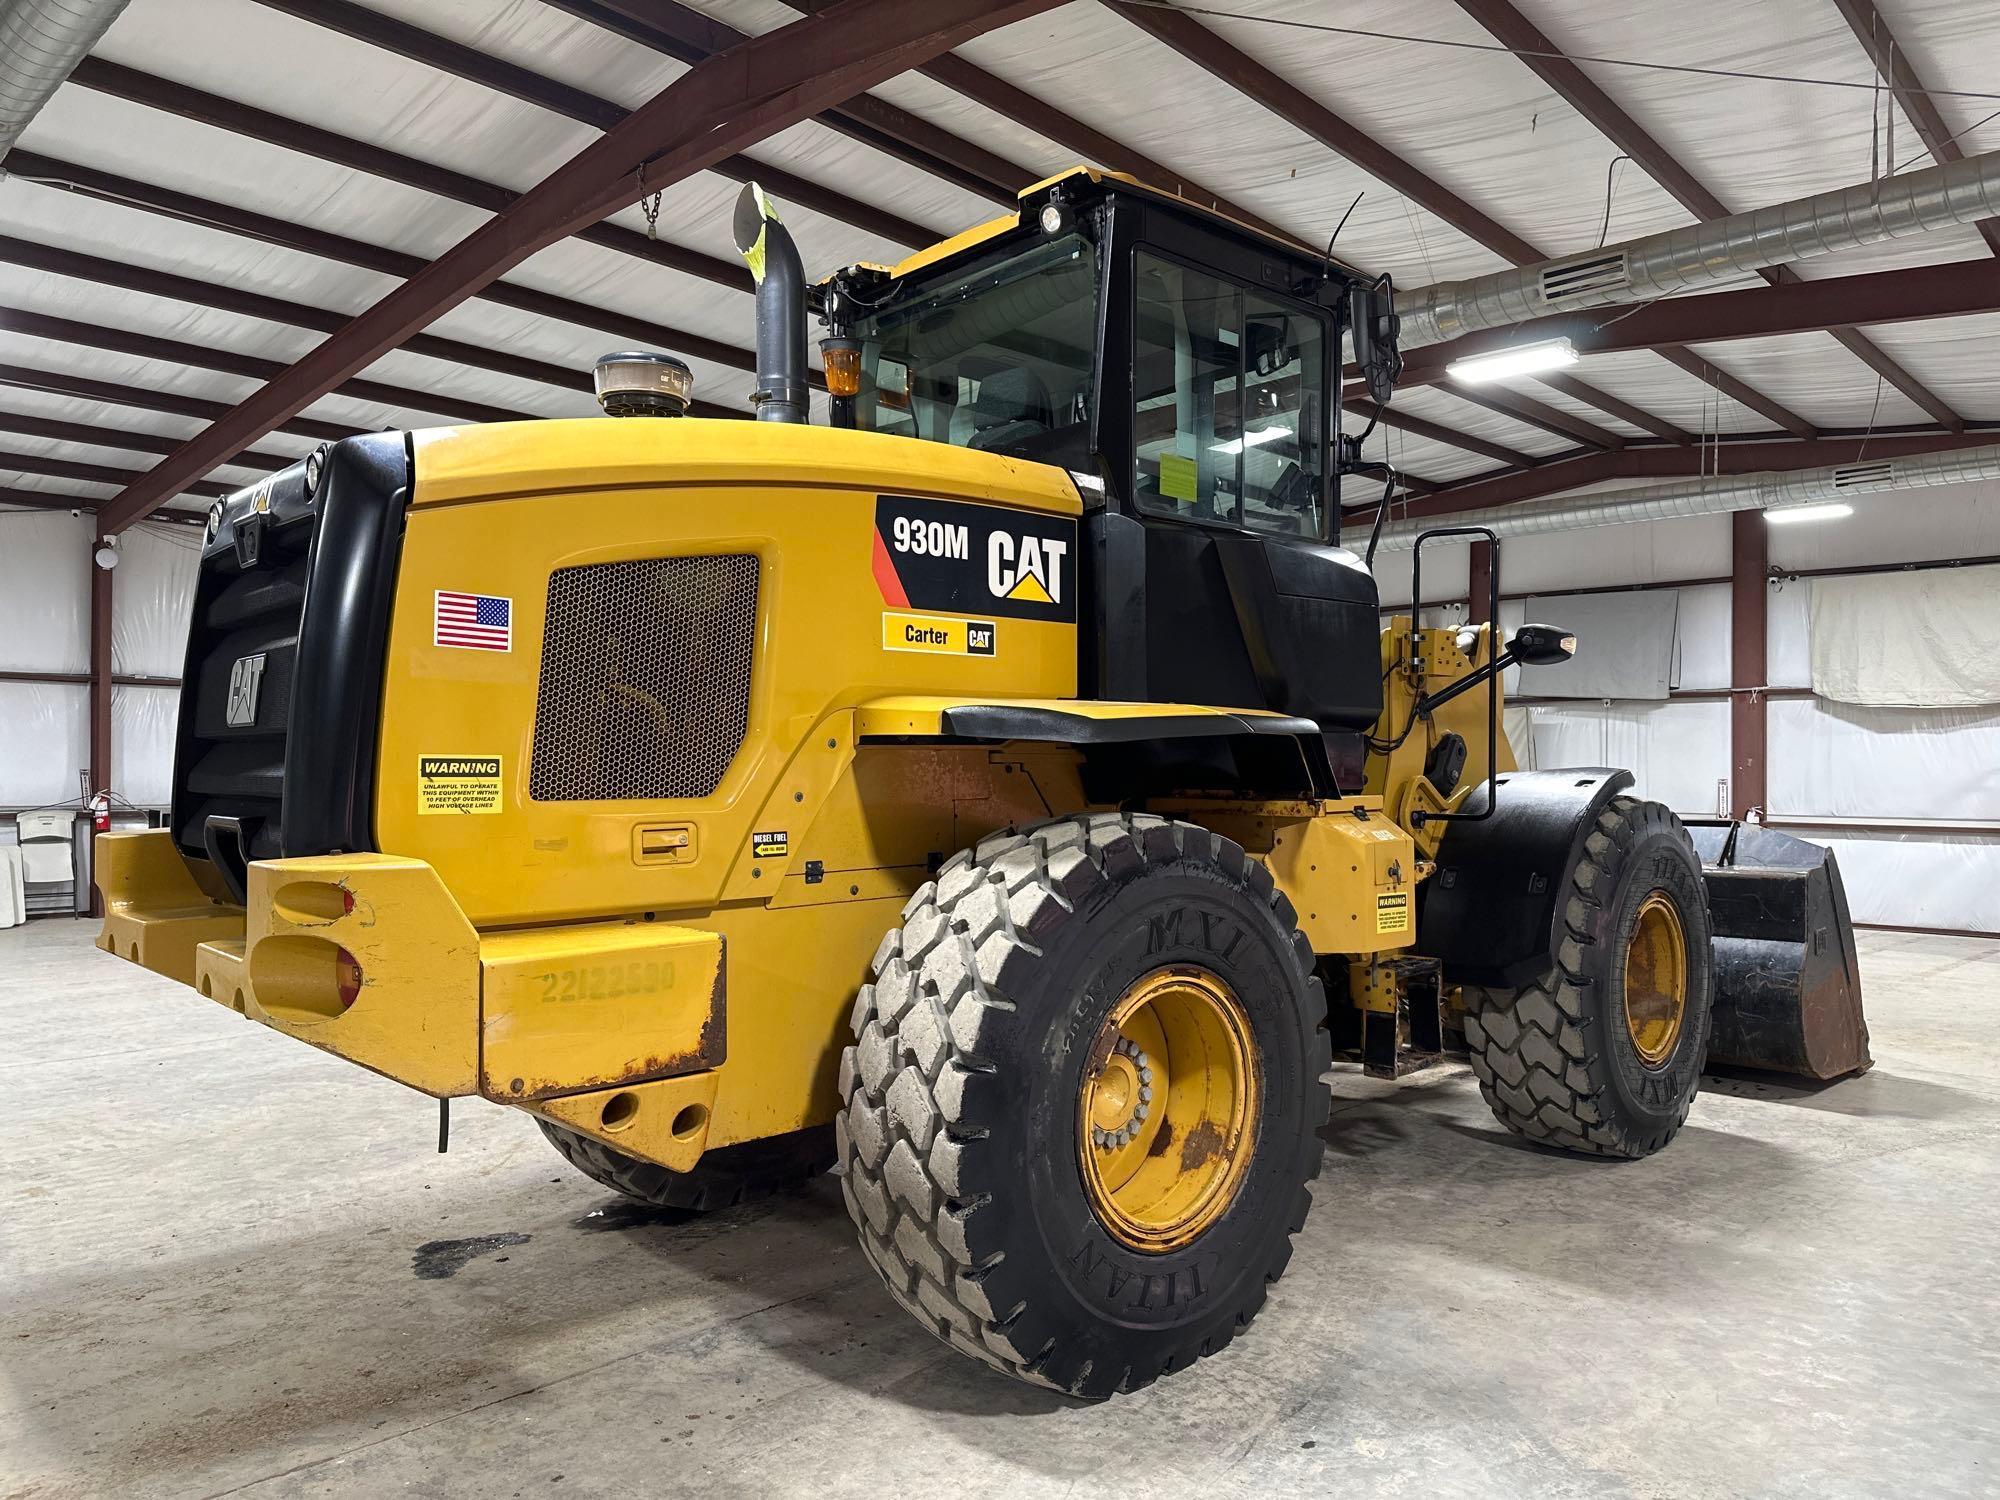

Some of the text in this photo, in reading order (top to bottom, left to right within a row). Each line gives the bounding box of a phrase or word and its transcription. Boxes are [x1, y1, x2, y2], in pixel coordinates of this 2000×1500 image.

[893, 516, 969, 560] 930M
[987, 530, 1067, 604] CAT
[905, 624, 948, 645] Carter
[969, 629, 992, 648] CAT
[226, 656, 265, 727] CAT
[425, 762, 497, 774] WARNING
[753, 833, 787, 843] DIESEL FUEL
[1379, 896, 1406, 907] WARNING
